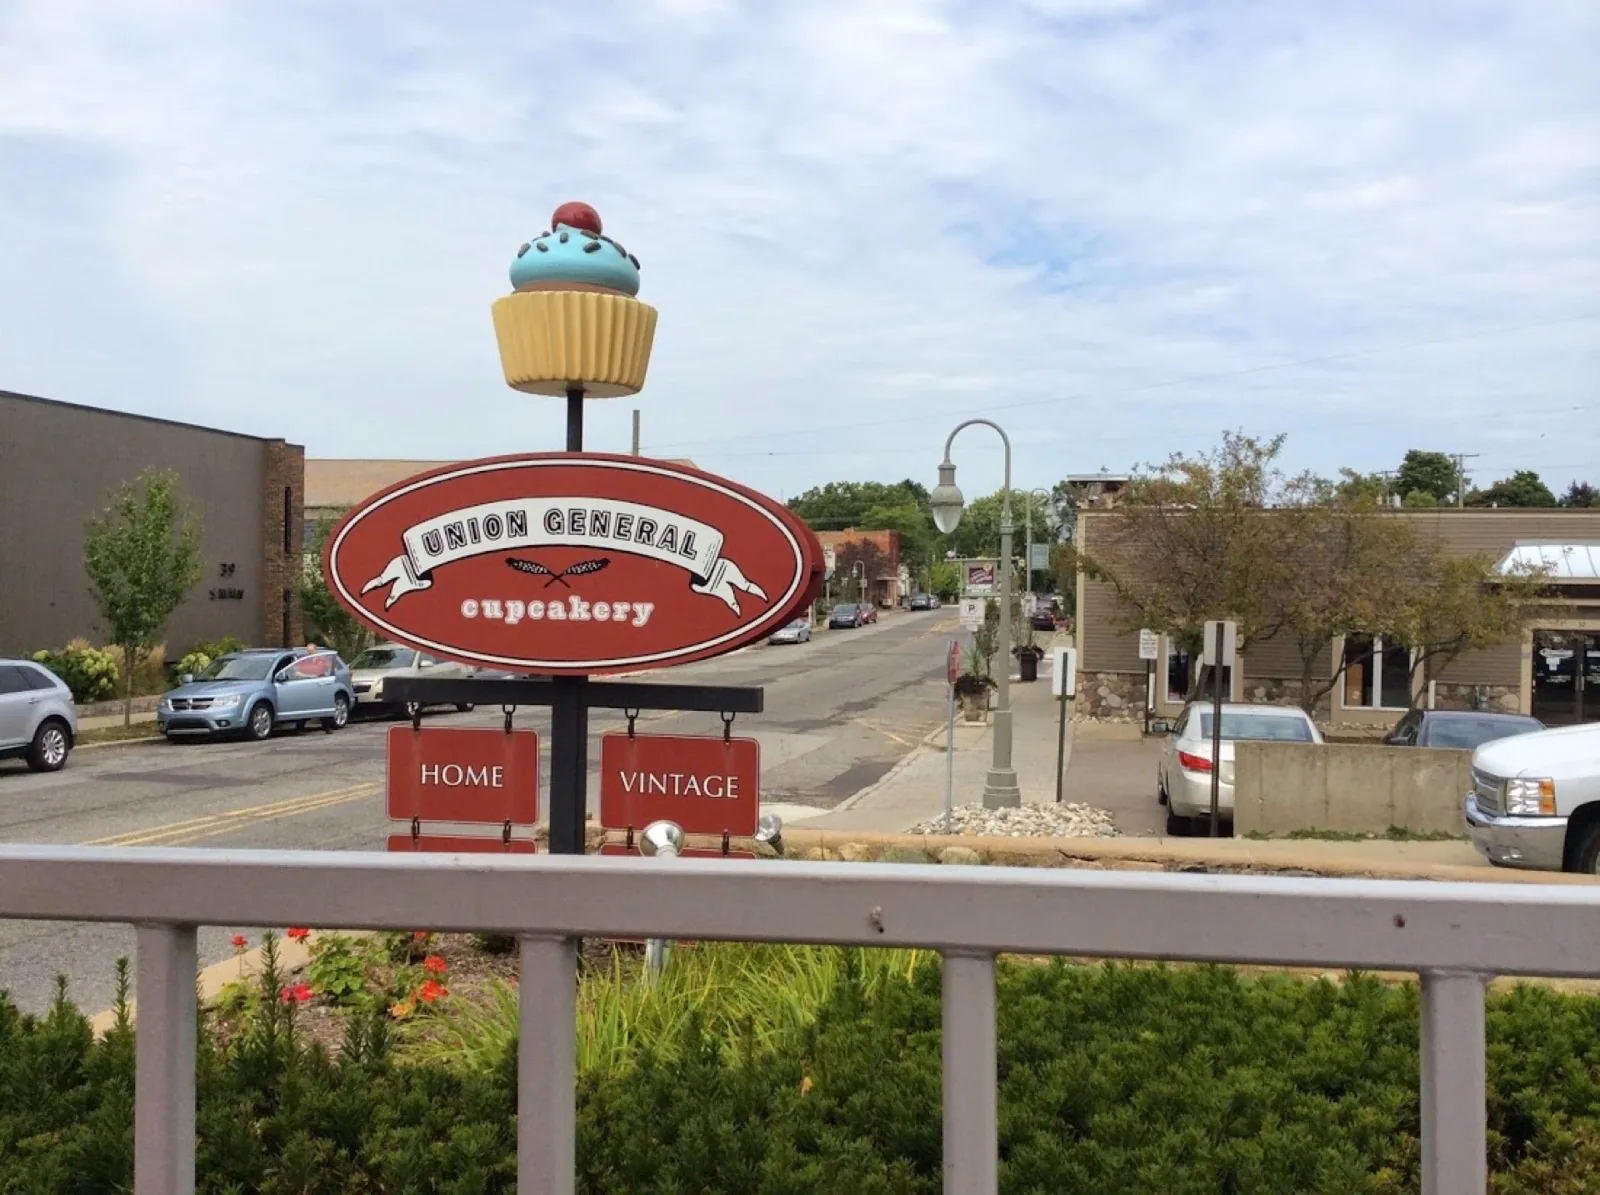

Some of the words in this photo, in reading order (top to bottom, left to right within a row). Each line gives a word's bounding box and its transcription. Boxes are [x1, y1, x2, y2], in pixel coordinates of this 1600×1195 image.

[421, 509, 528, 556] UNION
[543, 508, 698, 560] GENERAL
[460, 595, 655, 627] cupcakery
[421, 764, 503, 787] HOME
[619, 771, 739, 799] VINTAGE
